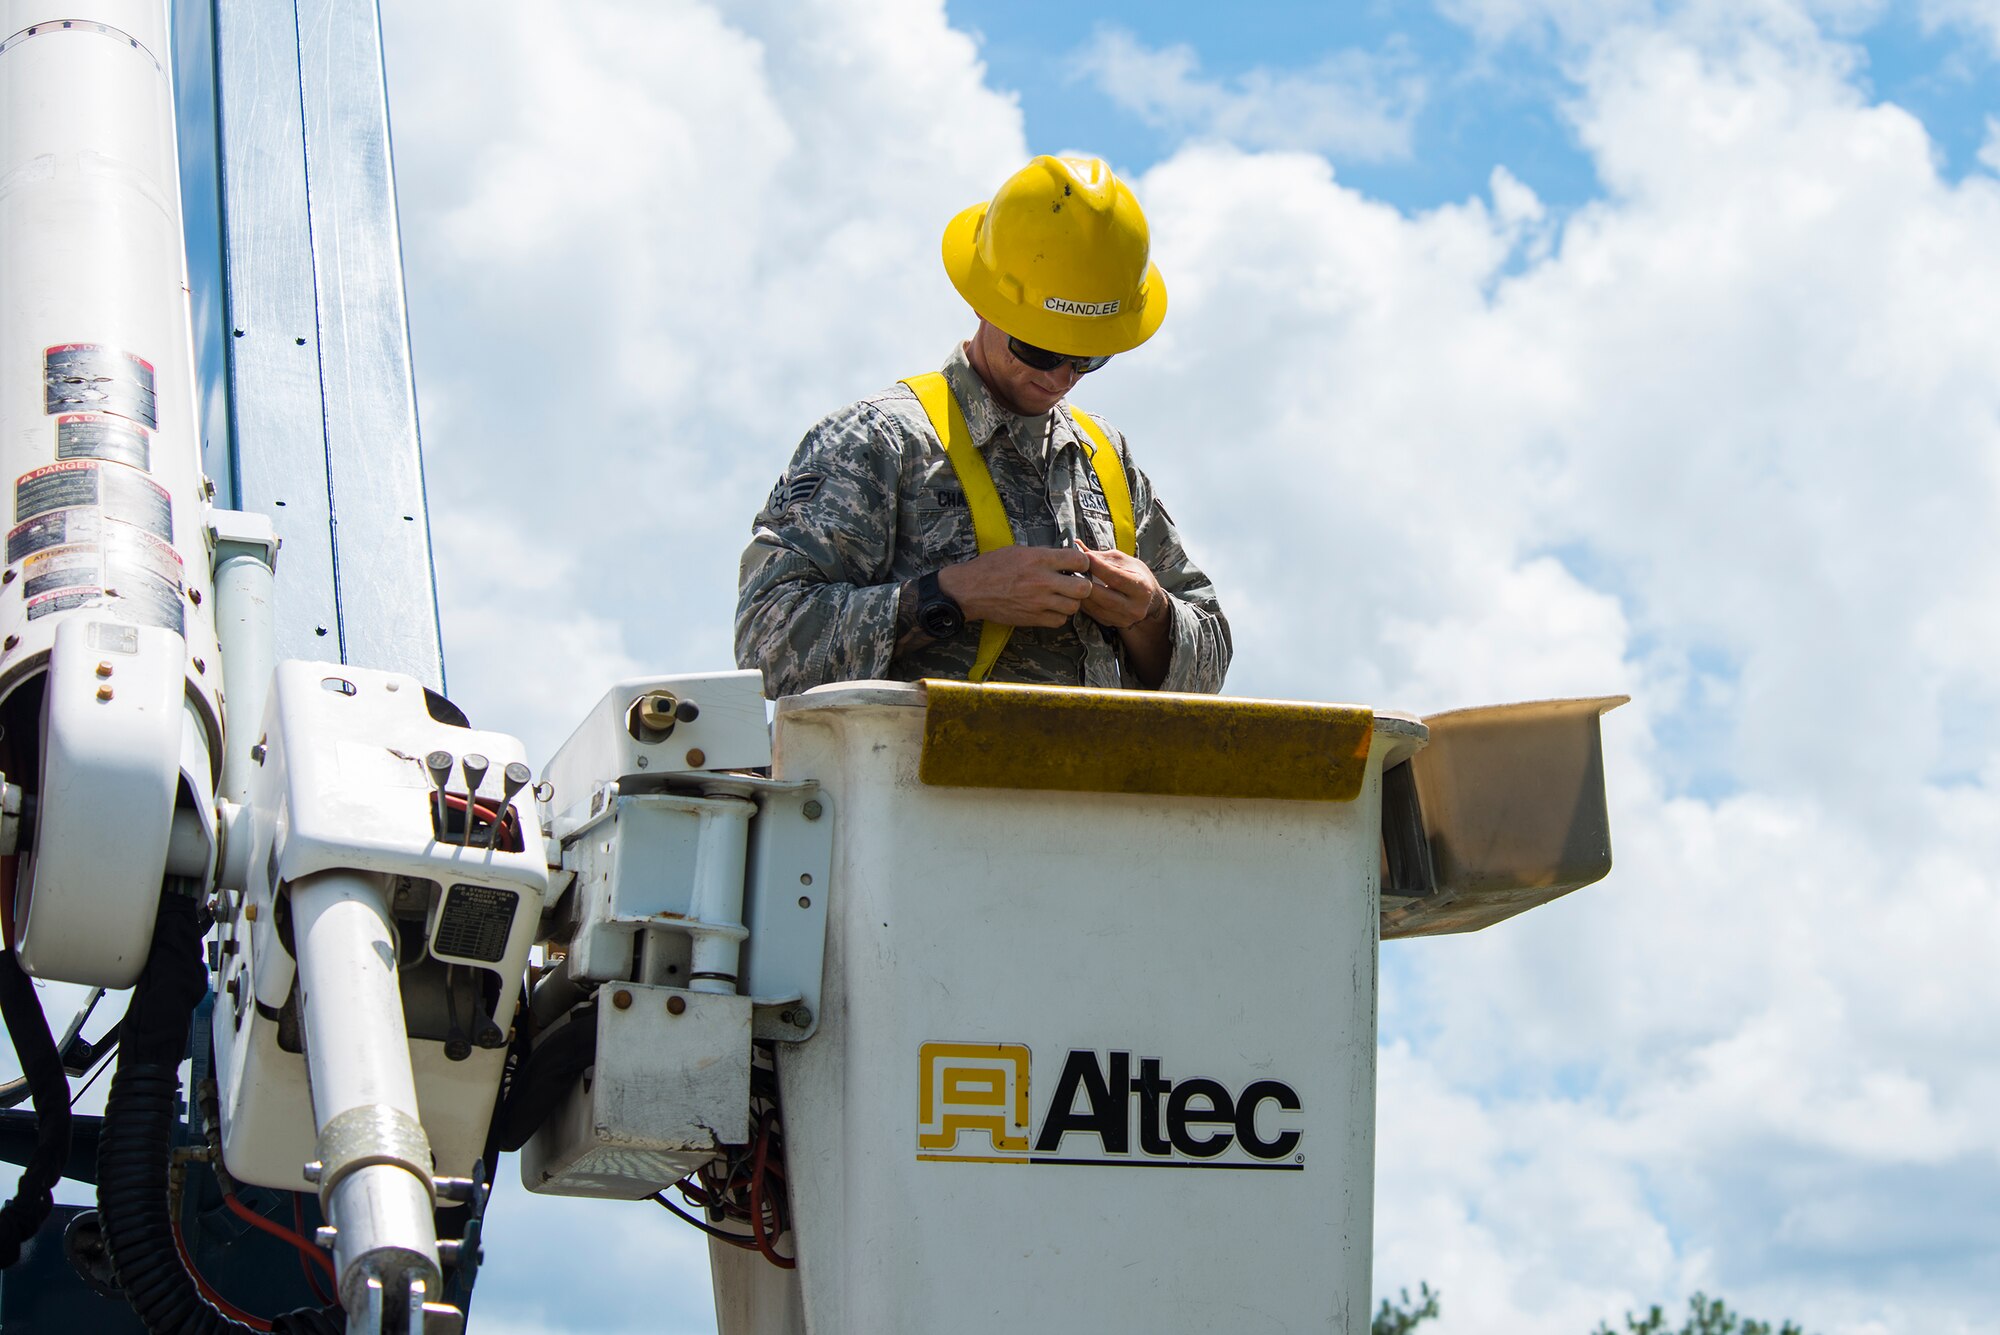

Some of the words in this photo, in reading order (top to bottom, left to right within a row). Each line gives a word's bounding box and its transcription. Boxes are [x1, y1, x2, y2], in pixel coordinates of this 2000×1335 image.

[1045, 298, 1119, 315] CHANDLEE
[36, 461, 97, 477] DANGER
[1034, 1050, 1301, 1159] Altec
